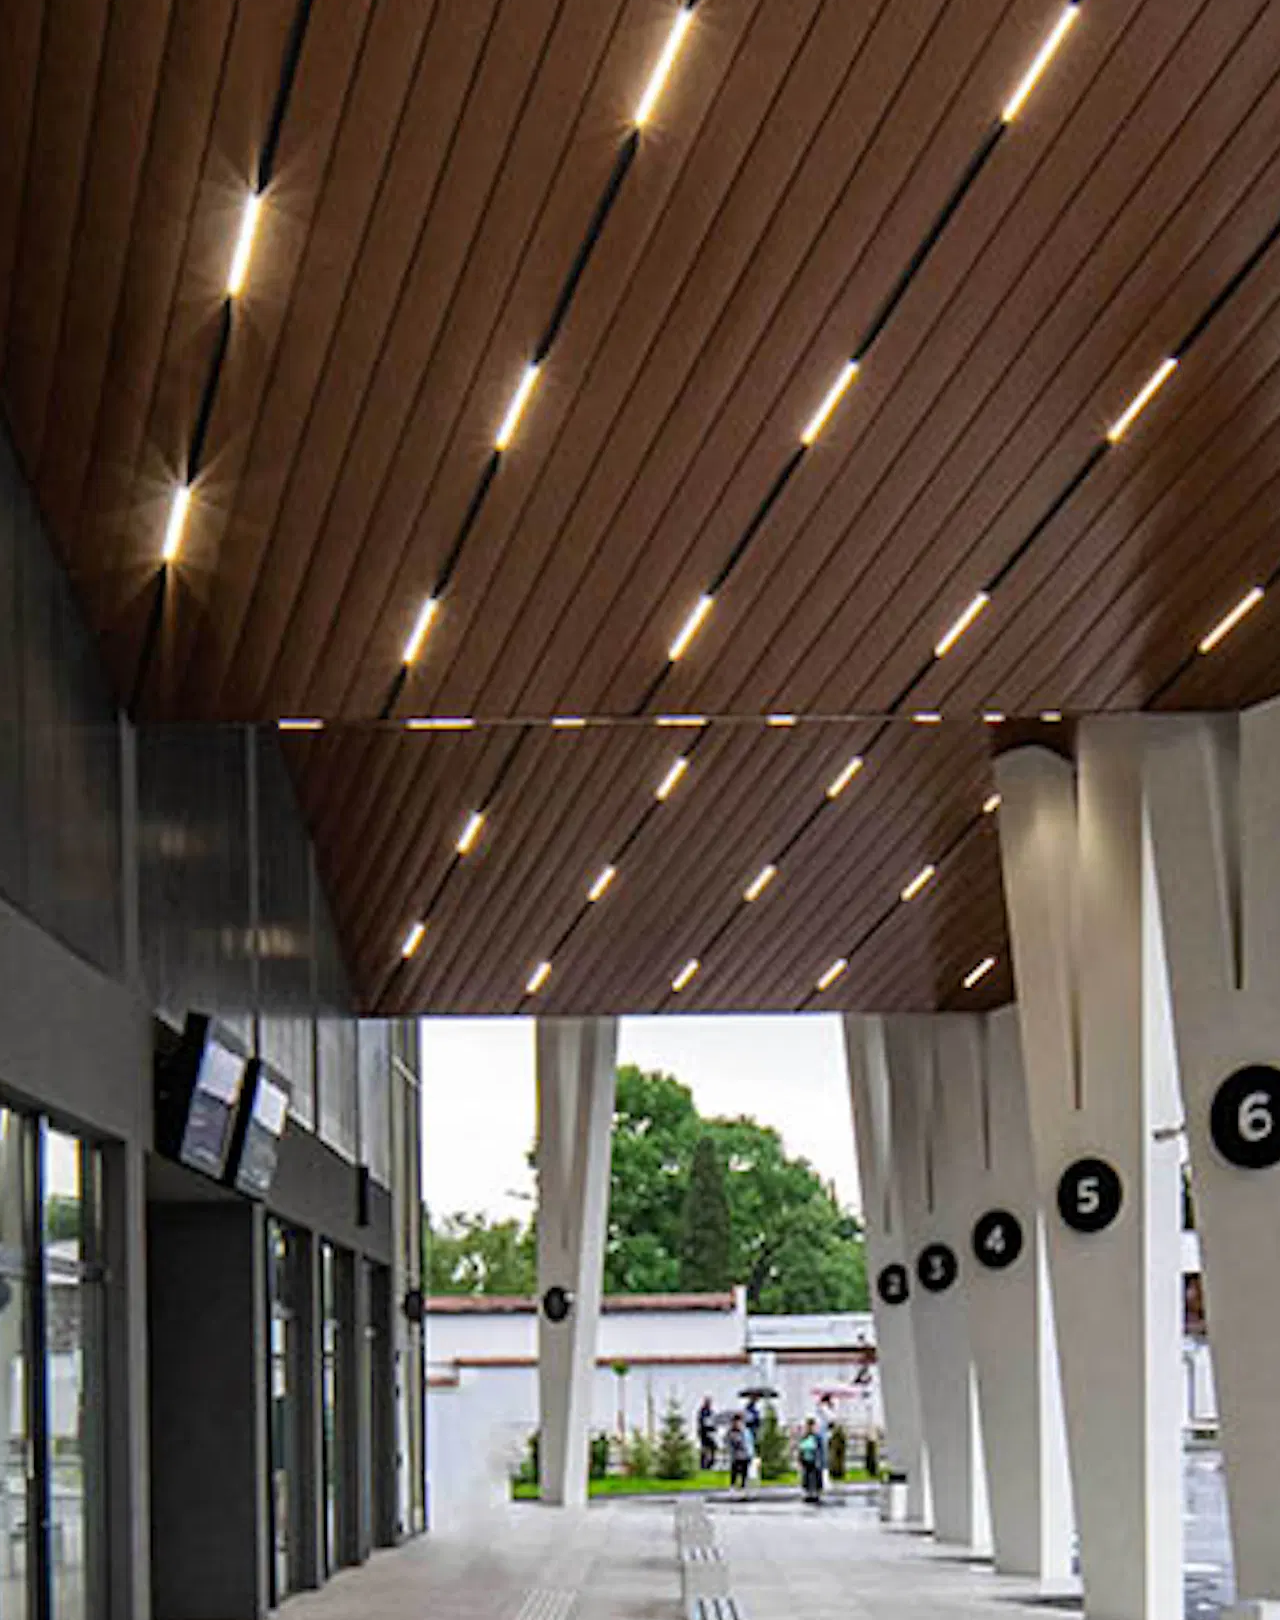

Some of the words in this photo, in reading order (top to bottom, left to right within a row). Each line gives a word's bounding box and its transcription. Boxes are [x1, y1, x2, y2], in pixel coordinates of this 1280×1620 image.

[1238, 1090, 1272, 1142] 6
[1076, 1176, 1100, 1214] 5
[984, 1223, 1007, 1255] 4
[927, 1253, 946, 1282] 3
